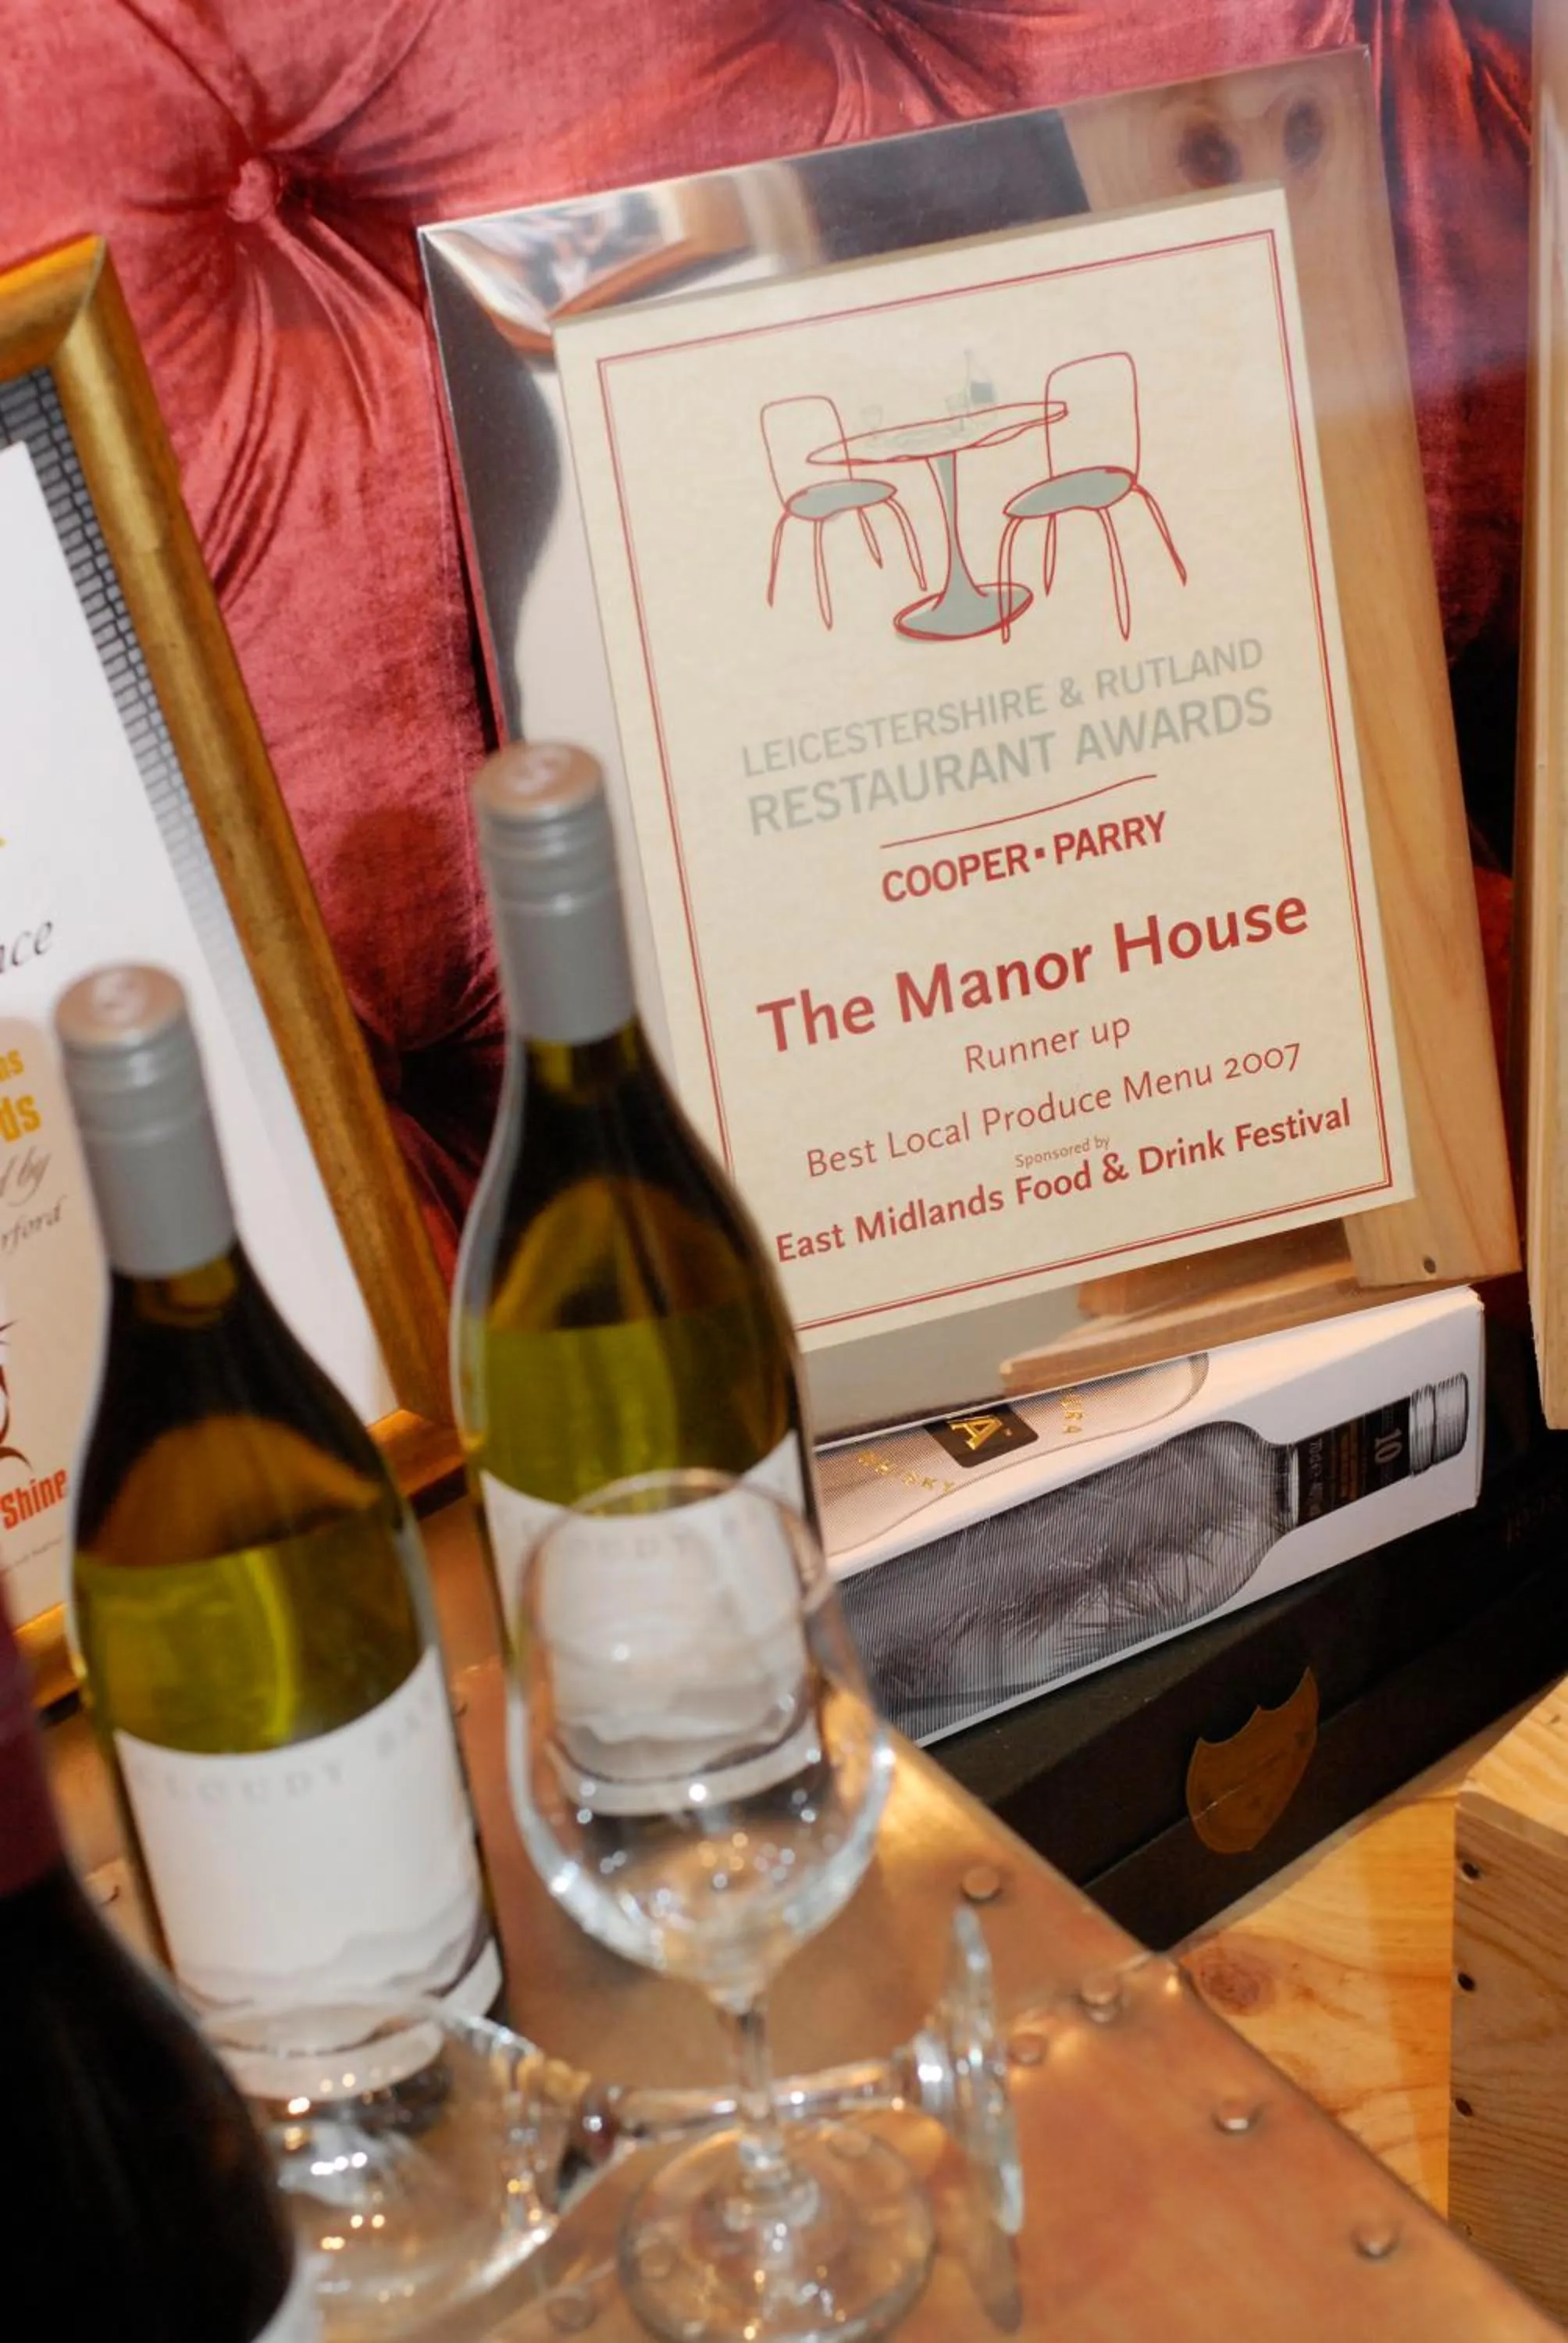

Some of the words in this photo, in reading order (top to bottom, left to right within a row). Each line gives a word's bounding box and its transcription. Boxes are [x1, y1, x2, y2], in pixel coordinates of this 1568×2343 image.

[741, 684, 1046, 777] LEICESTERSHIRE
[1059, 676, 1085, 709] &
[1096, 638, 1263, 701] RUTLAND
[747, 731, 1057, 836] RESTAURANT
[1074, 686, 1273, 765] AWARDS
[756, 988, 875, 1052] The
[896, 944, 1093, 1023] Manor
[1114, 897, 1309, 973] House
[807, 1139, 877, 1178] Best
[887, 1111, 970, 1159] Local
[982, 1086, 1113, 1137] Produce
[1123, 1064, 1213, 1104] Menu
[1224, 1042, 1301, 1080] 2007
[964, 1025, 1080, 1074] Runner
[1091, 1016, 1131, 1049] up
[775, 1226, 846, 1264] East
[855, 1183, 1004, 1243] Midlands
[1015, 1161, 1092, 1205] Food
[1102, 1152, 1130, 1184] &
[1138, 1129, 1225, 1175] Drink
[1235, 1097, 1351, 1152] Festival
[1014, 1136, 1091, 1168] Sponsored
[1094, 1132, 1111, 1152] by
